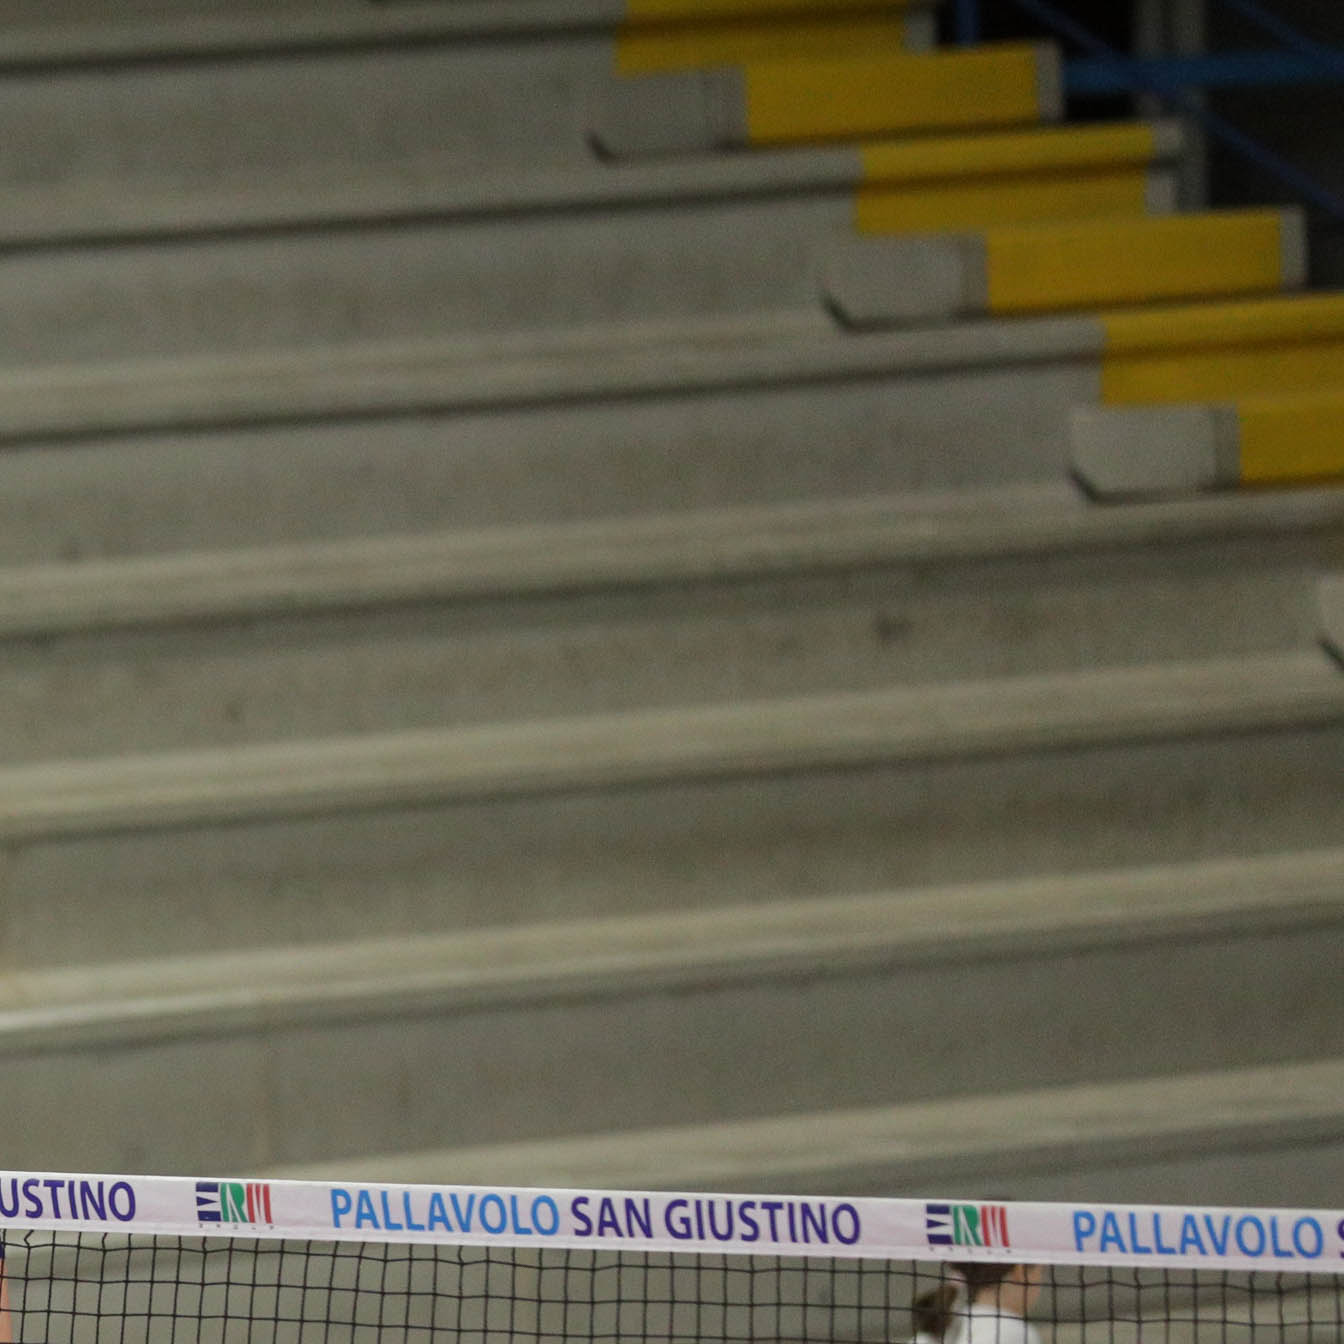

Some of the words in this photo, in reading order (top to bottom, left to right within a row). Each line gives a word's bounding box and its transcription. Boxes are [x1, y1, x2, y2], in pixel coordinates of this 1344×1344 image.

[330, 1186, 560, 1237] PALLAVOLO
[570, 1196, 653, 1237] SAN
[664, 1199, 862, 1246] GIUSTINO
[1072, 1208, 1324, 1260] PALLAVOLO
